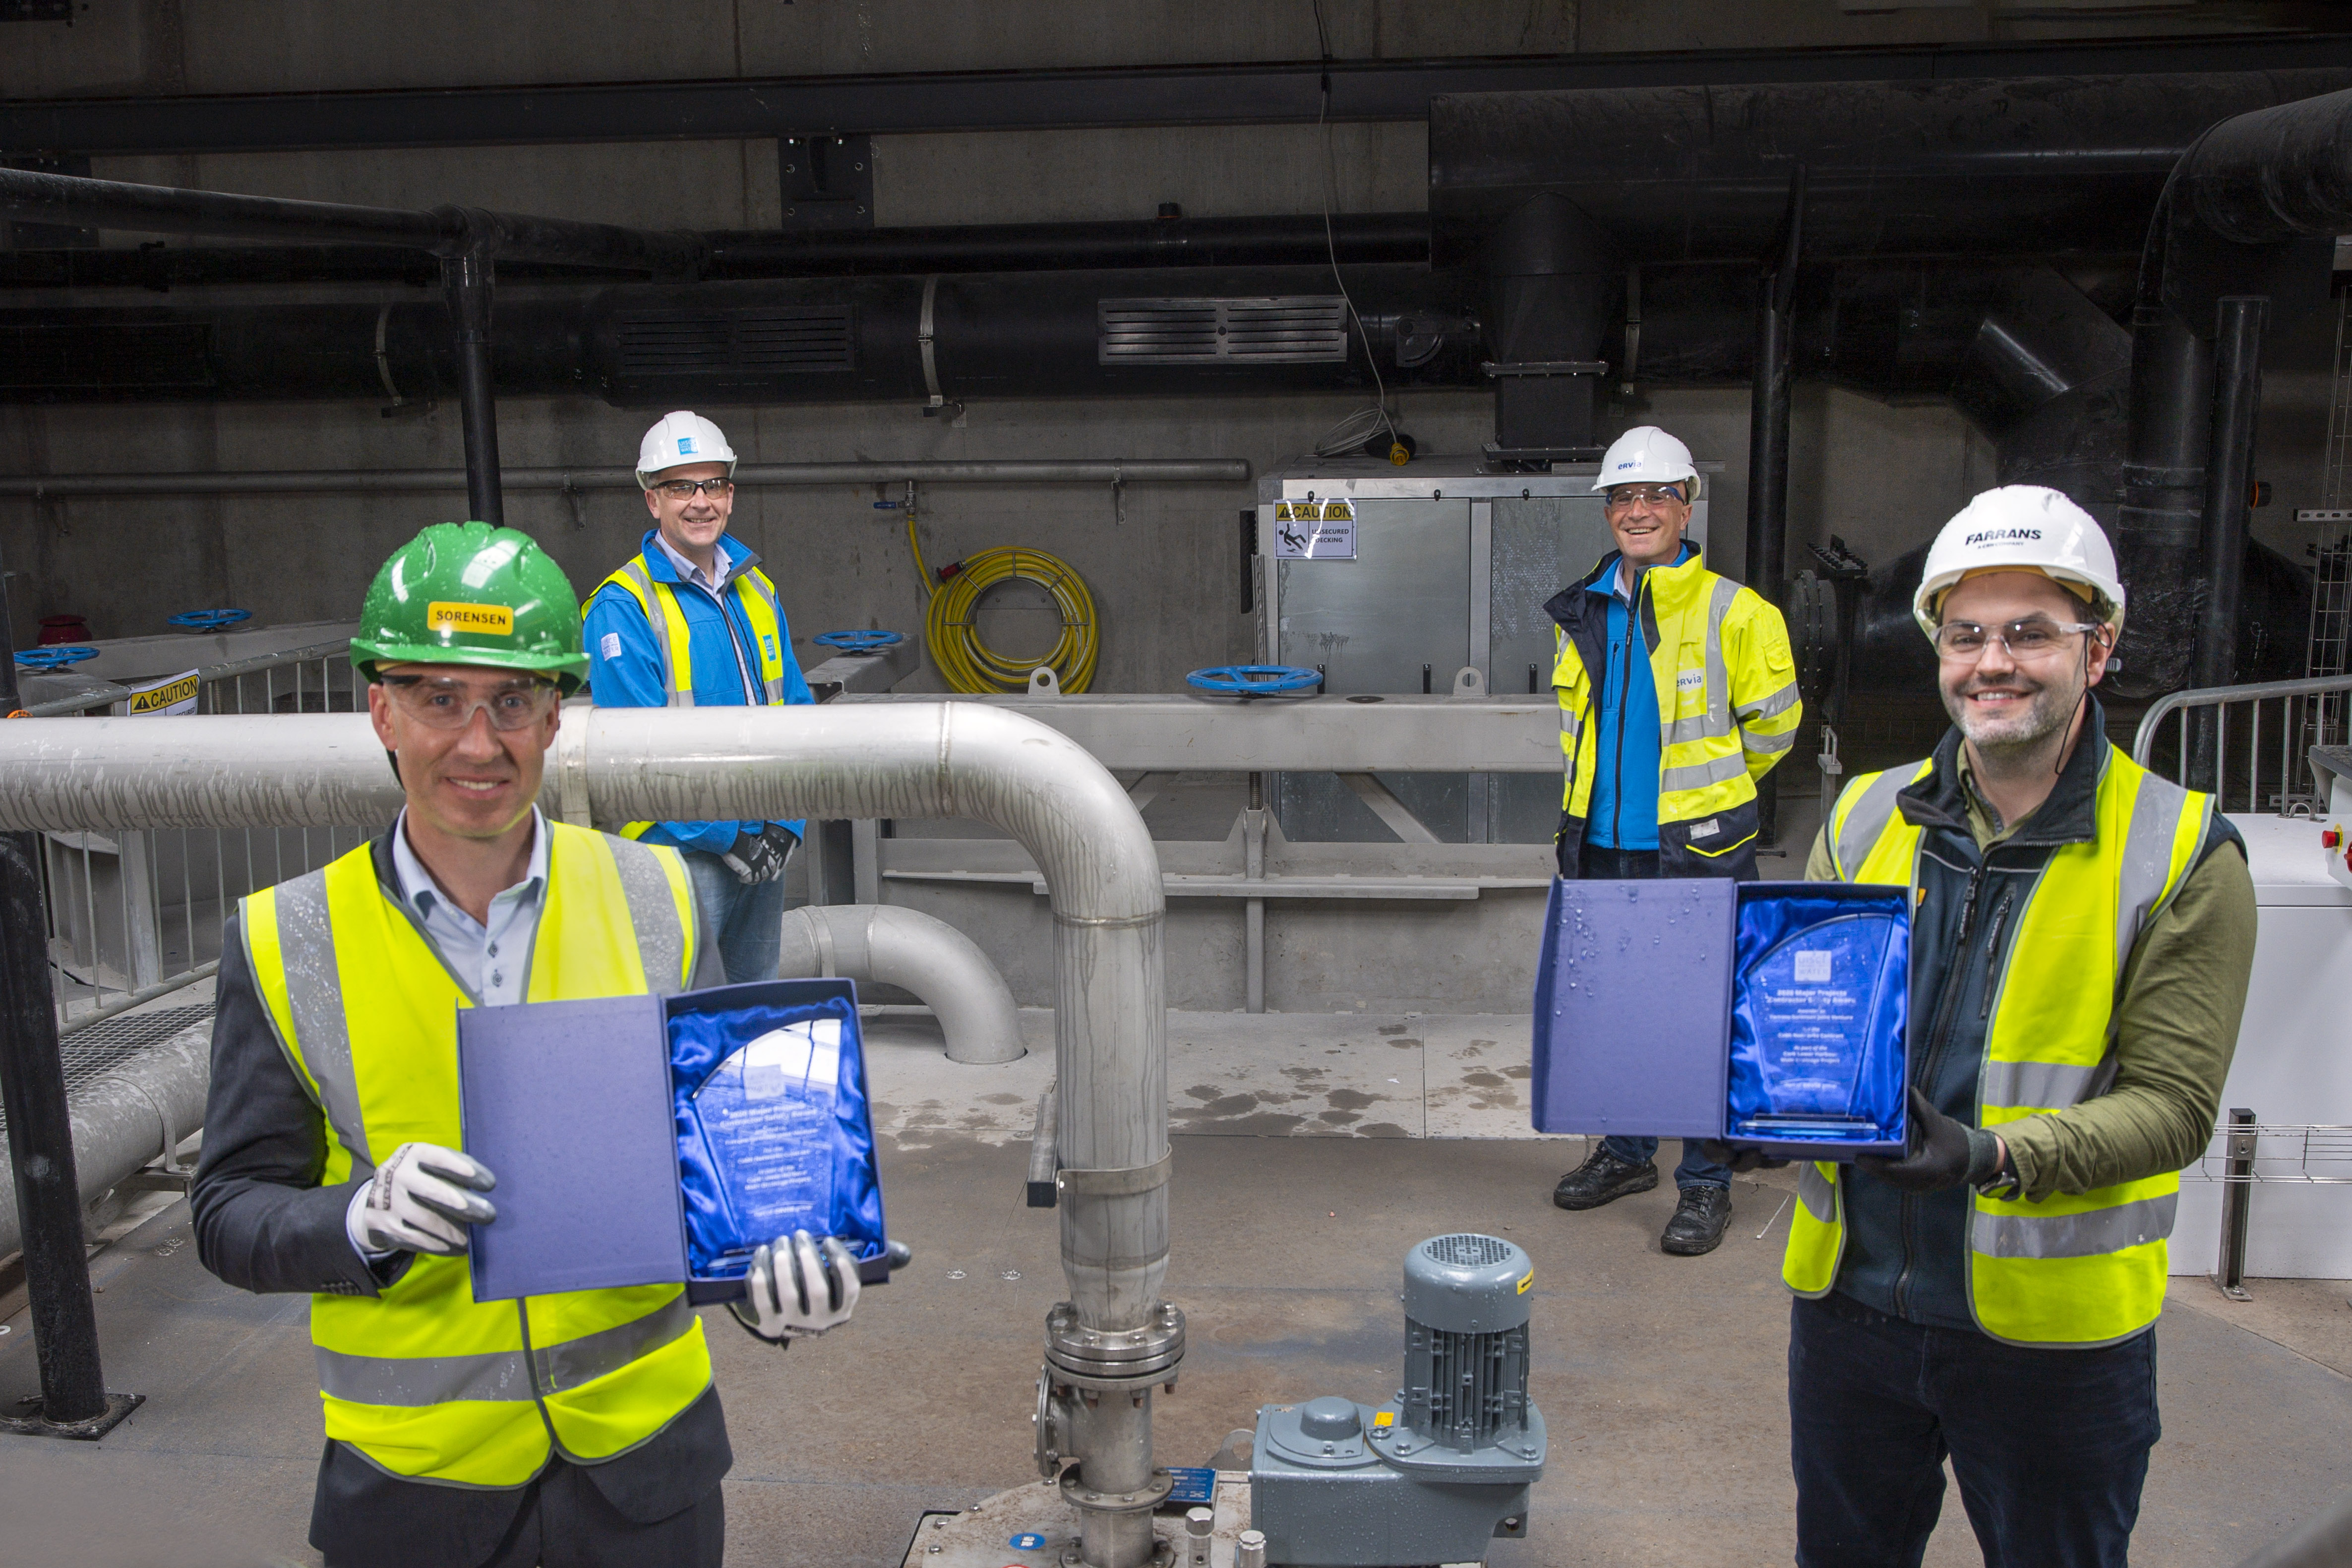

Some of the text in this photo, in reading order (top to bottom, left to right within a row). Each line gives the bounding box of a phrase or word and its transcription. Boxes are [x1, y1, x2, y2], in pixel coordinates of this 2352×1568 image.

[1965, 529, 2042, 545] FARRANS
[436, 610, 506, 624] SORENSEN
[151, 679, 197, 707] CAUTION
